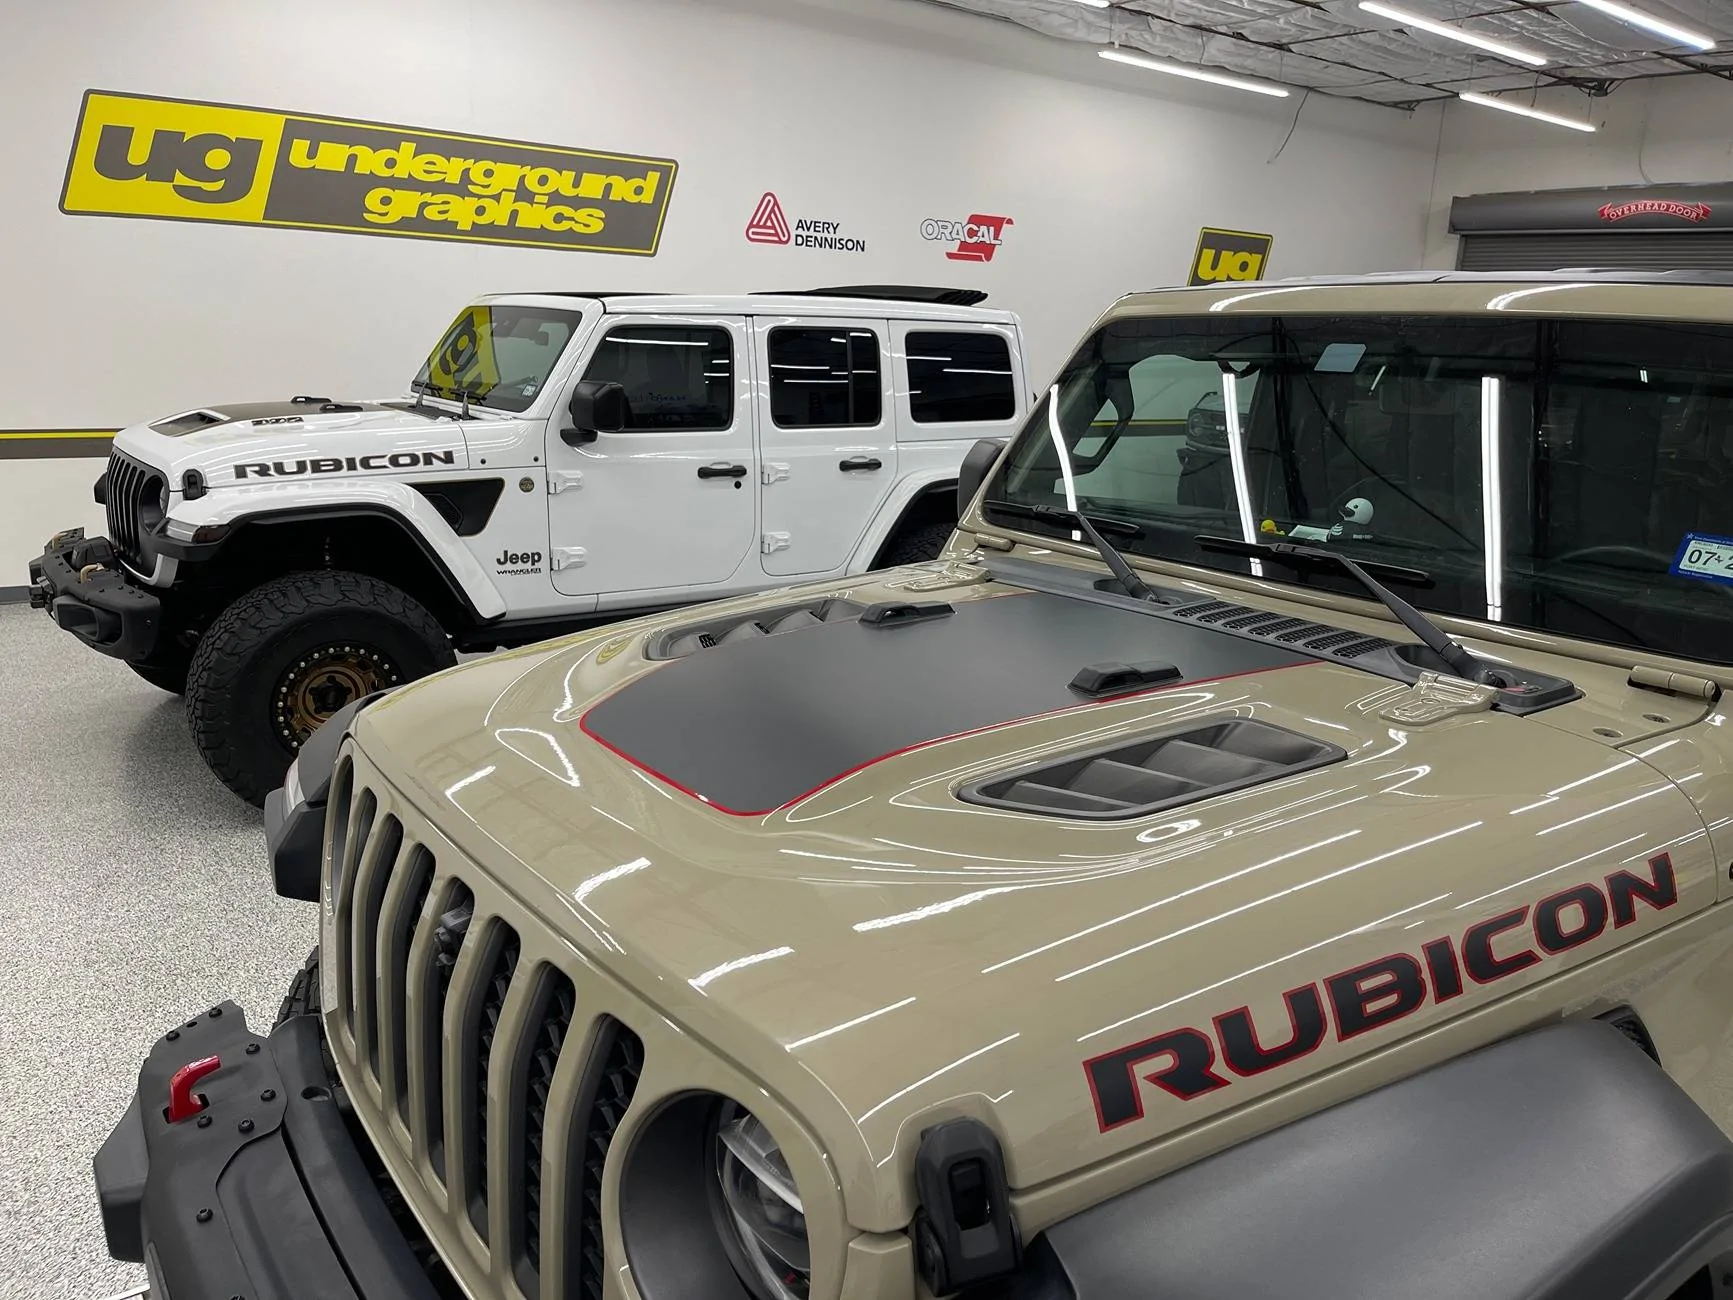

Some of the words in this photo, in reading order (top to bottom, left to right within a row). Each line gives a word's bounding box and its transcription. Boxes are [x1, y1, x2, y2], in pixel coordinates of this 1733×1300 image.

[93, 124, 264, 205] ug
[288, 138, 661, 205] underground
[362, 186, 606, 235] graphics
[1608, 202, 1667, 219] OVERHEAD
[1669, 203, 1698, 220] DOOR
[795, 219, 840, 235] AVERY
[919, 218, 1003, 246] ORACAL
[794, 234, 866, 252] DENNISON
[233, 450, 455, 480] RUBICON
[496, 550, 542, 566] Jeep
[1082, 852, 1679, 1134] RUBICON
